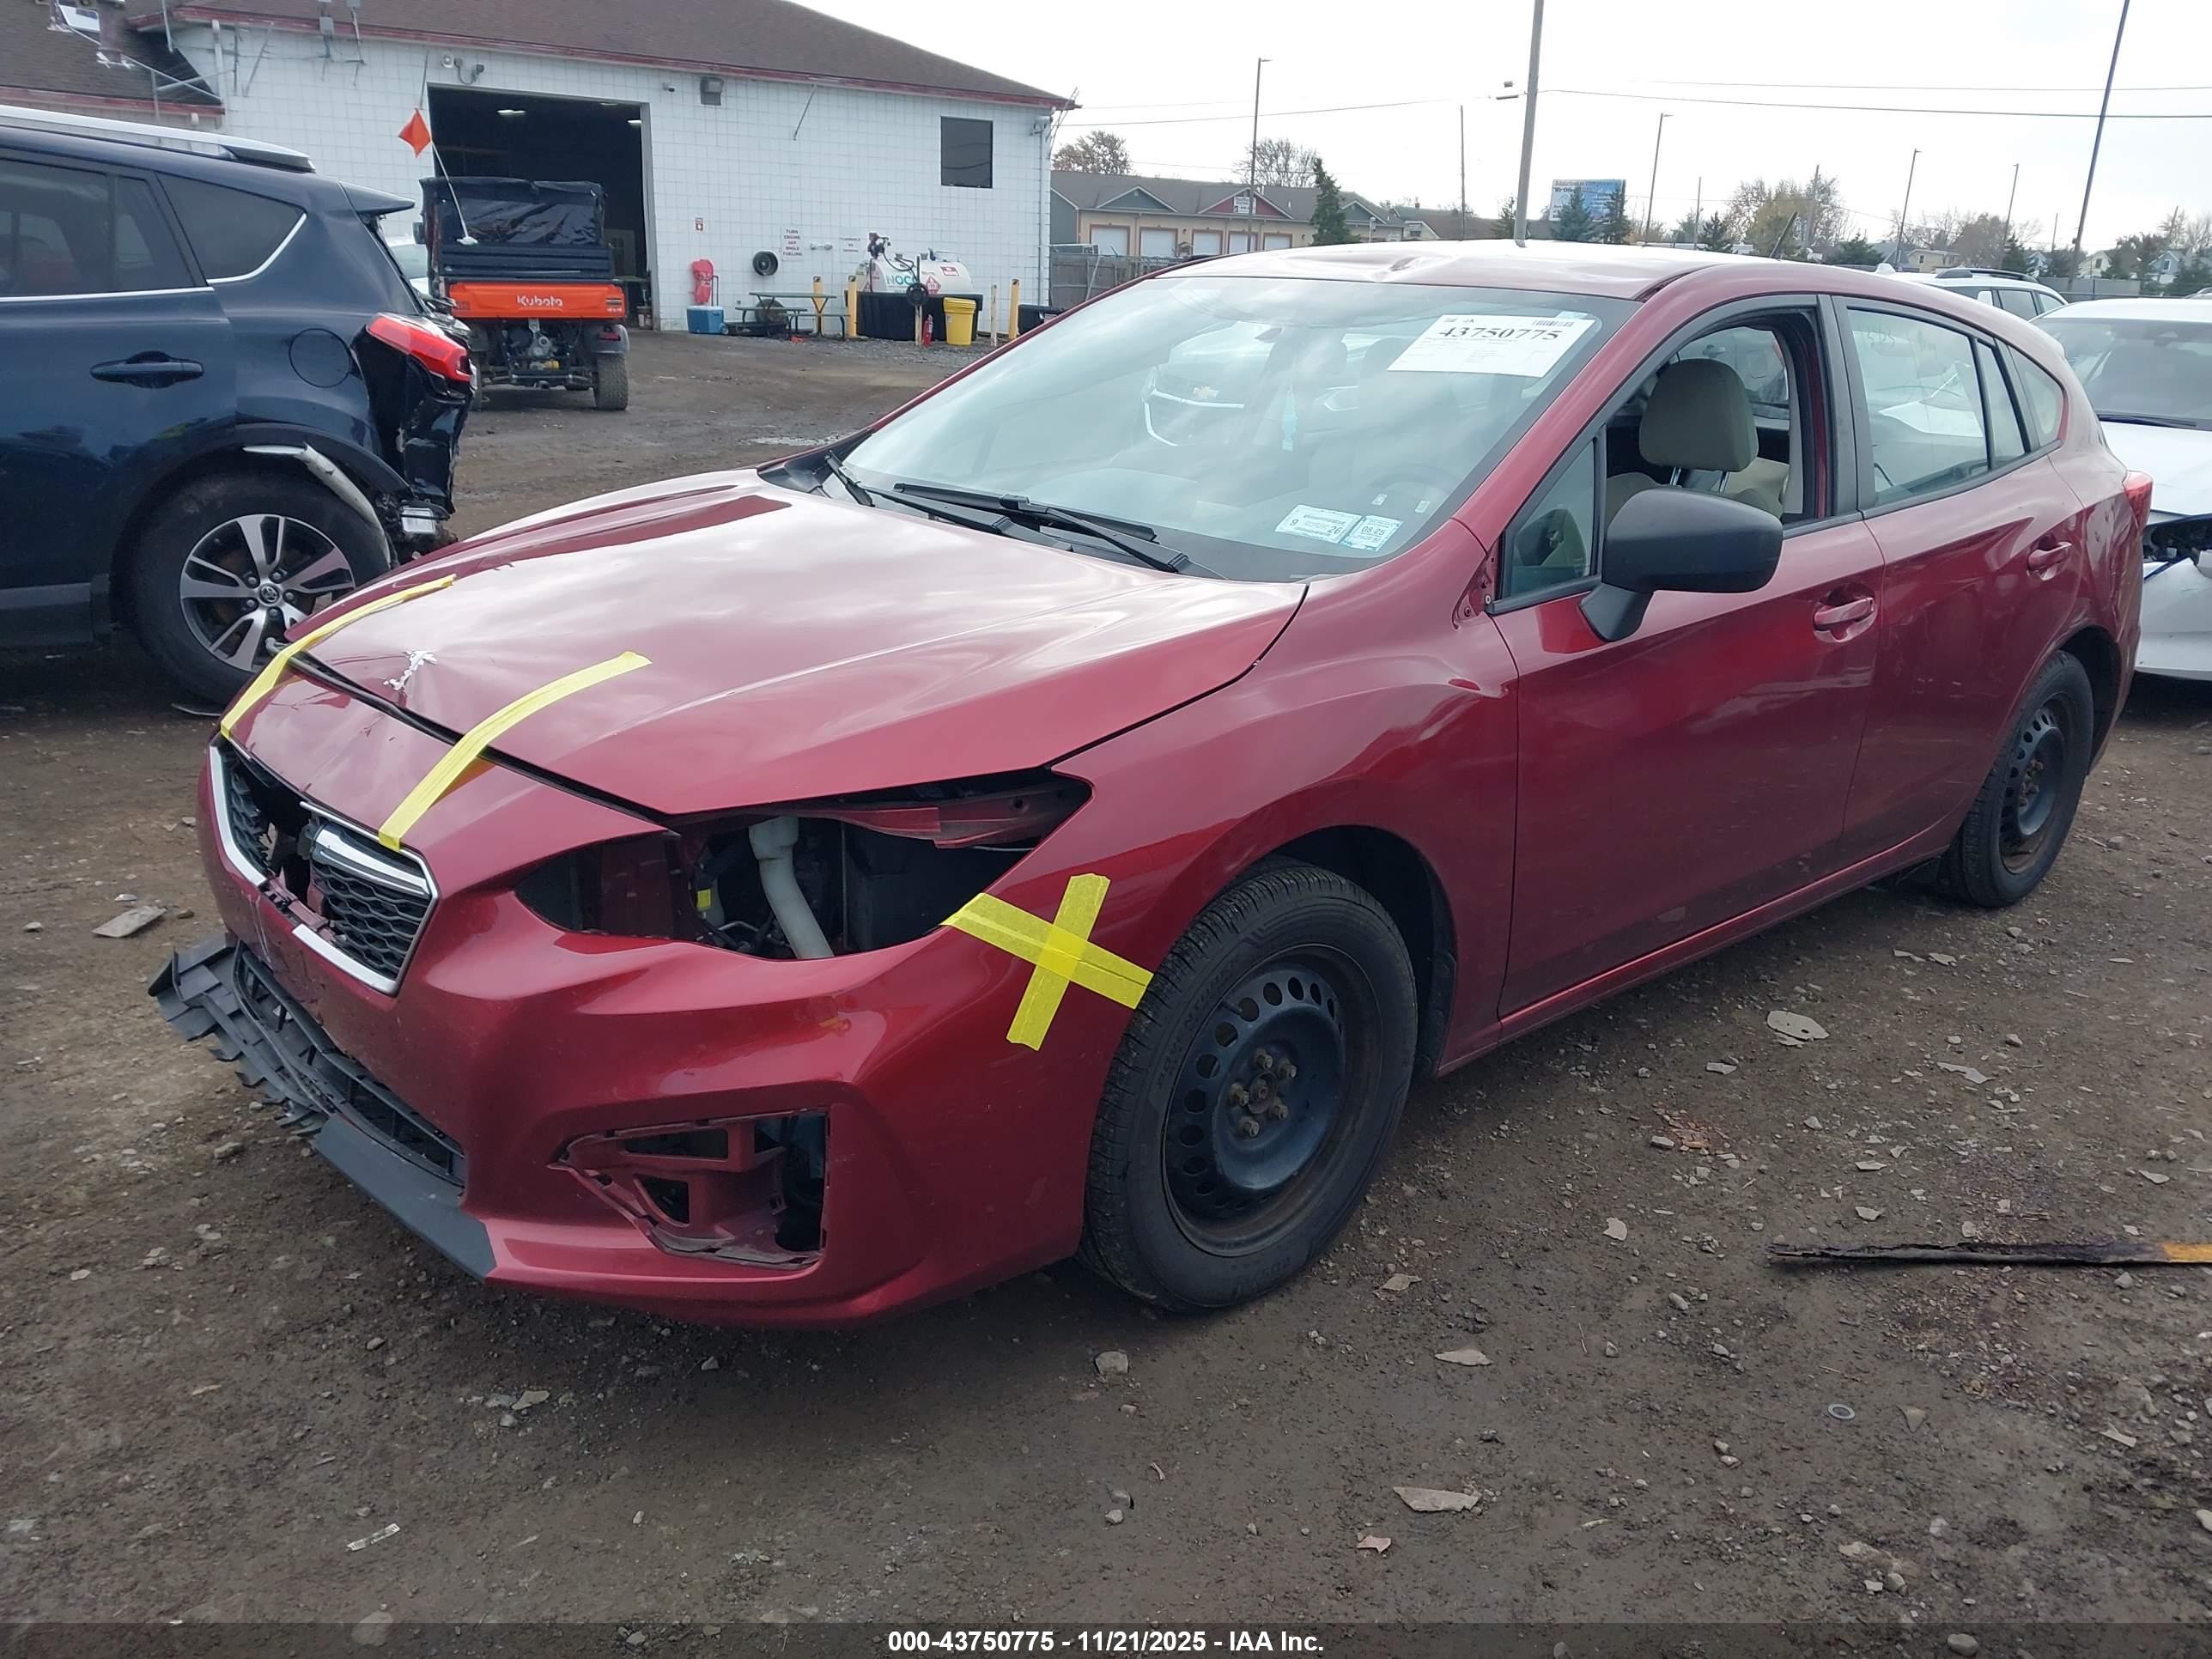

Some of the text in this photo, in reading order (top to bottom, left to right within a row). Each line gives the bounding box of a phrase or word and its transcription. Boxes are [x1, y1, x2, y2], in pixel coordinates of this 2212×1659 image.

[517, 295, 563, 307] Kubota
[1439, 326, 1563, 340] 43750775
[1327, 526, 1343, 534] 26
